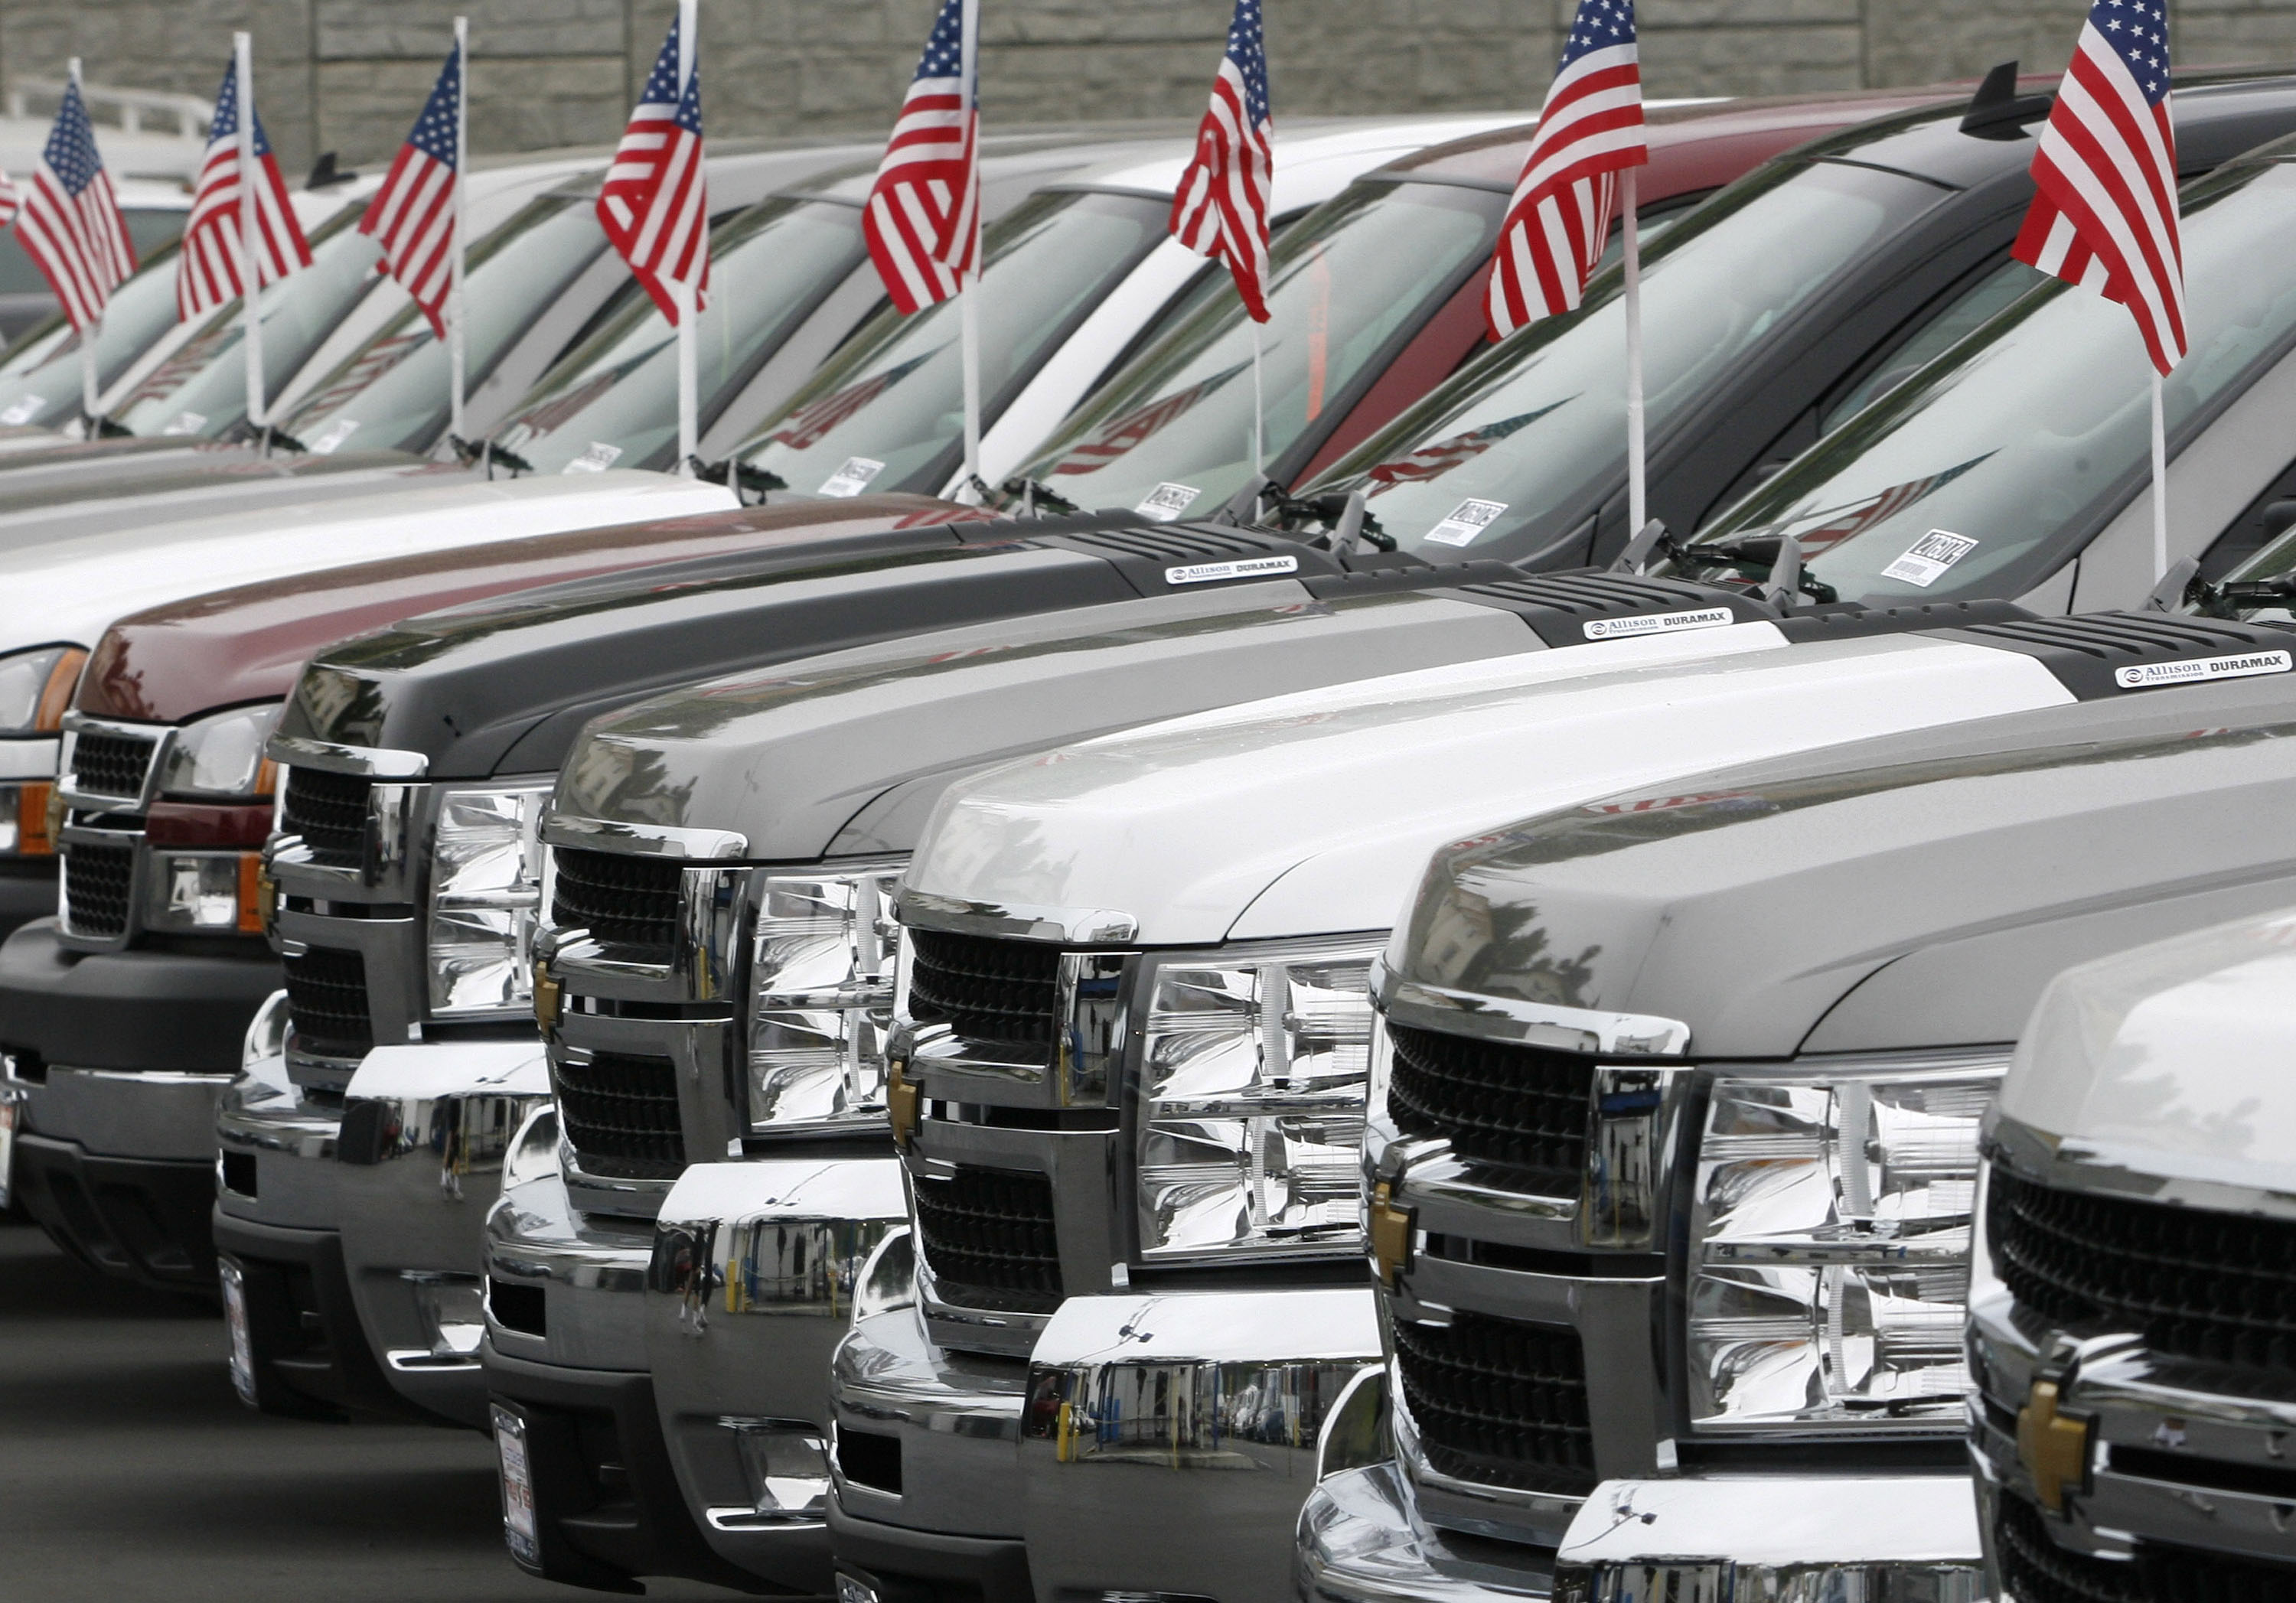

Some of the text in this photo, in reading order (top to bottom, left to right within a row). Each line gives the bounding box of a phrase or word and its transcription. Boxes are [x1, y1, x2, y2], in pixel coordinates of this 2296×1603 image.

[1188, 560, 1291, 575] Allison DURAMAX
[1609, 612, 1726, 629] Allison DURAMAX
[2145, 656, 2283, 676] Allison DURAMAX
[2145, 672, 2204, 682] Transmission
